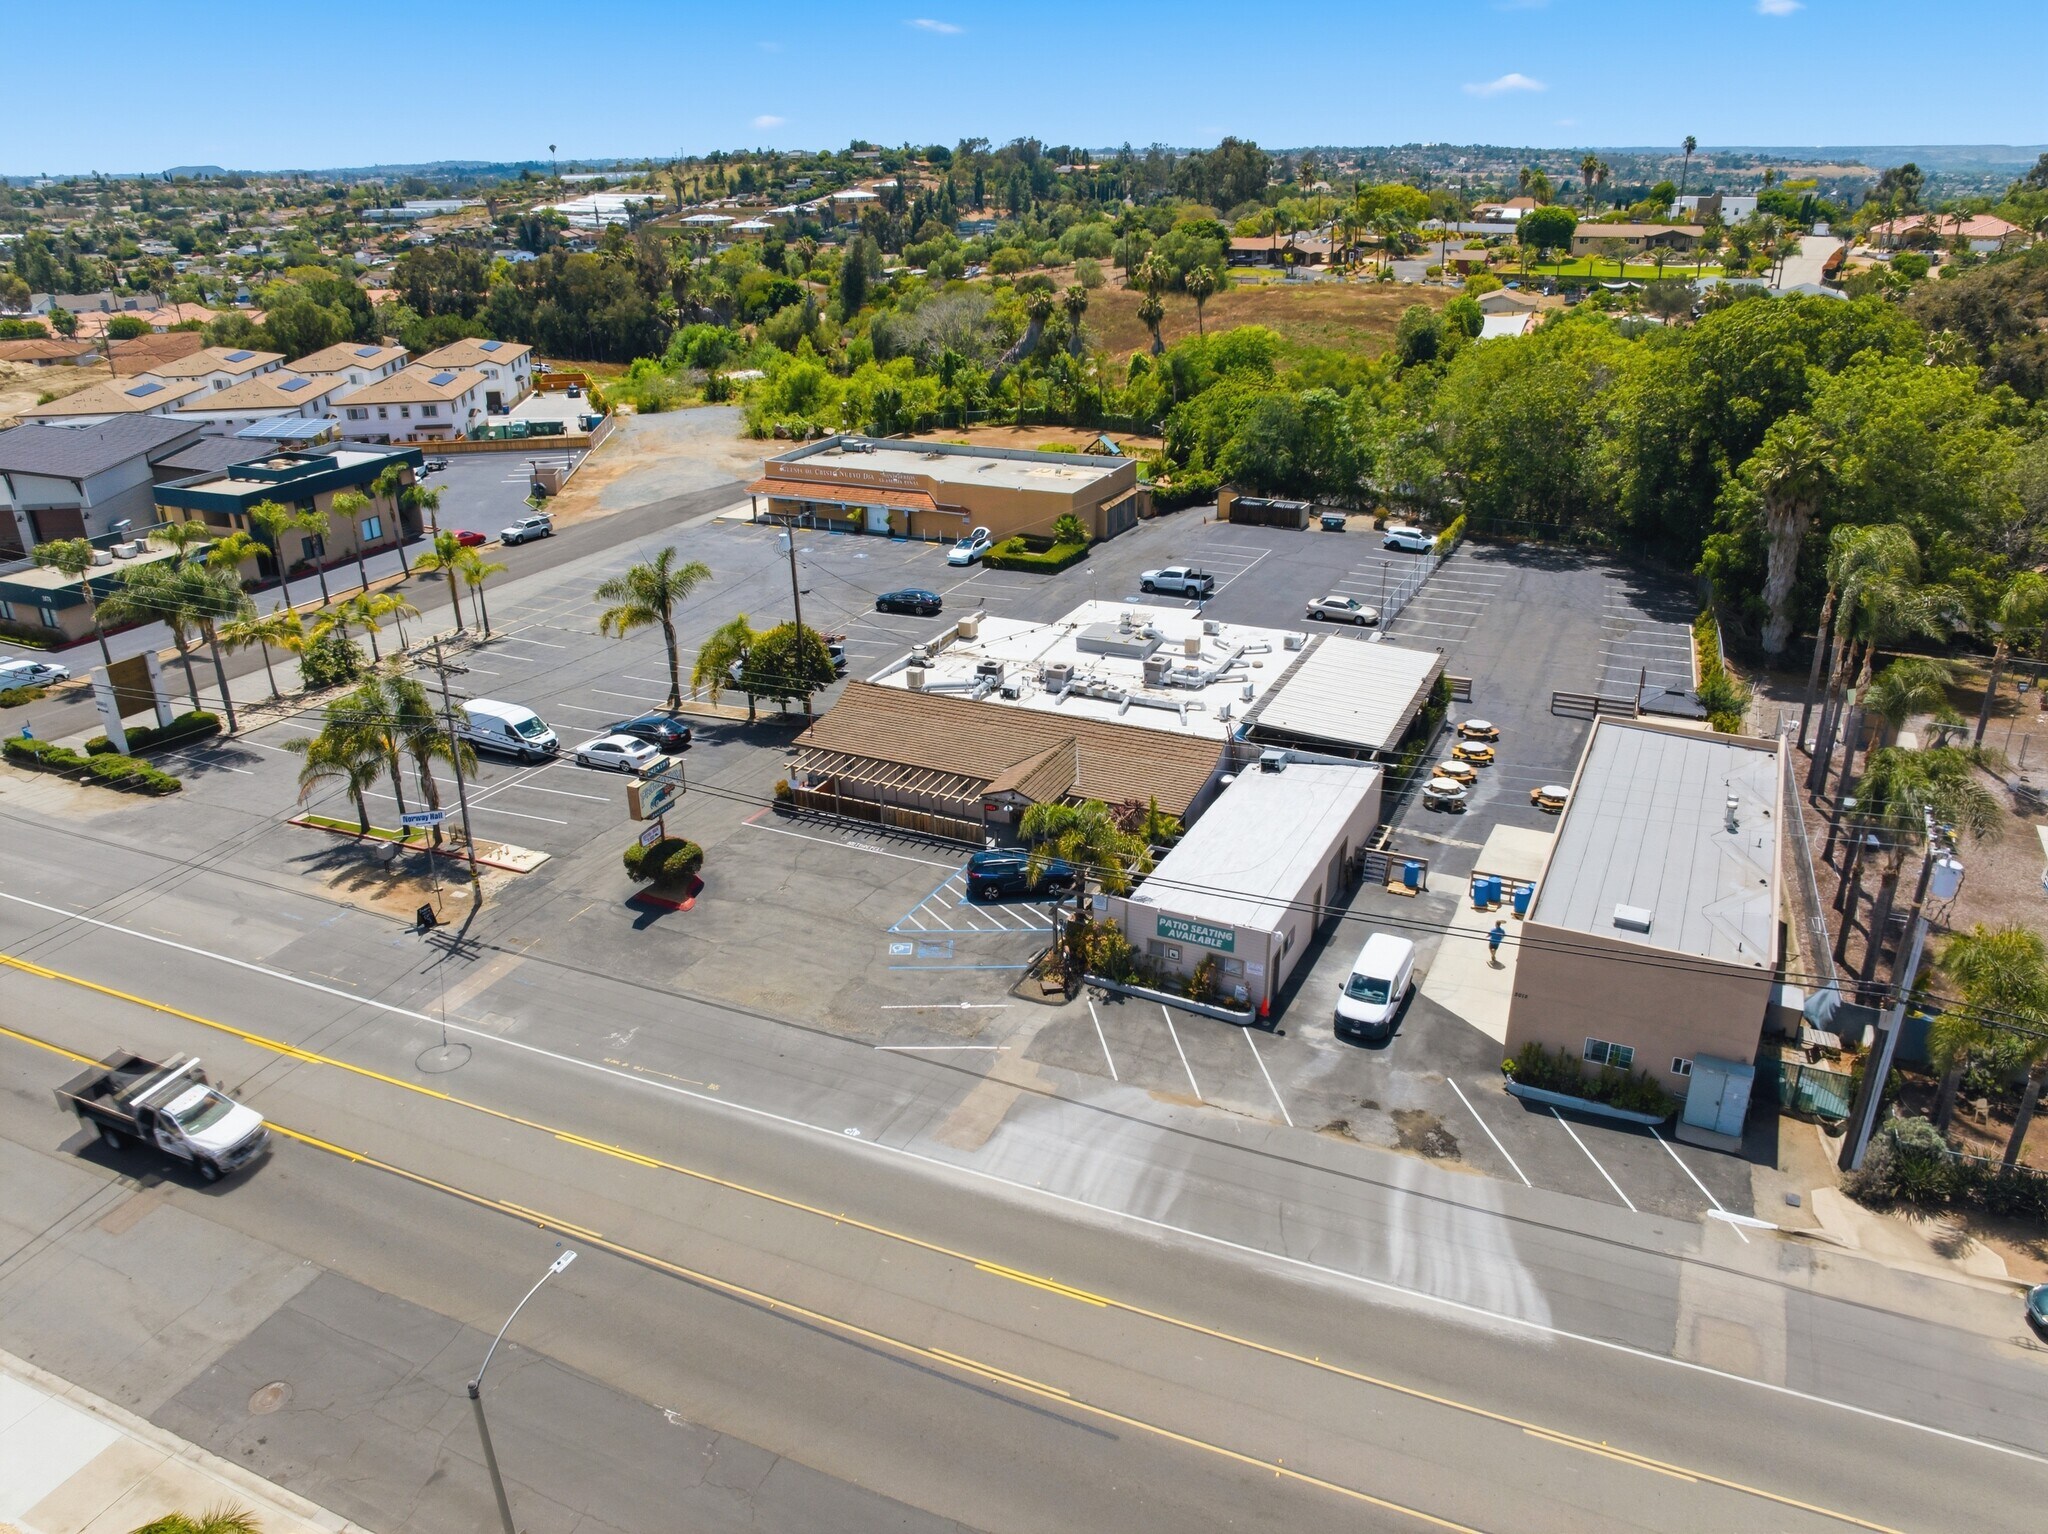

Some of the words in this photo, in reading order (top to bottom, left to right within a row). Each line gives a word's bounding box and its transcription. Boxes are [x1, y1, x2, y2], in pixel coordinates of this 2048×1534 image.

[403, 814, 429, 823] Norway
[430, 812, 443, 820] Hall
[1159, 918, 1189, 931] PATIO
[1190, 925, 1233, 941] SEATING
[1168, 929, 1223, 947] AVAILABLE
